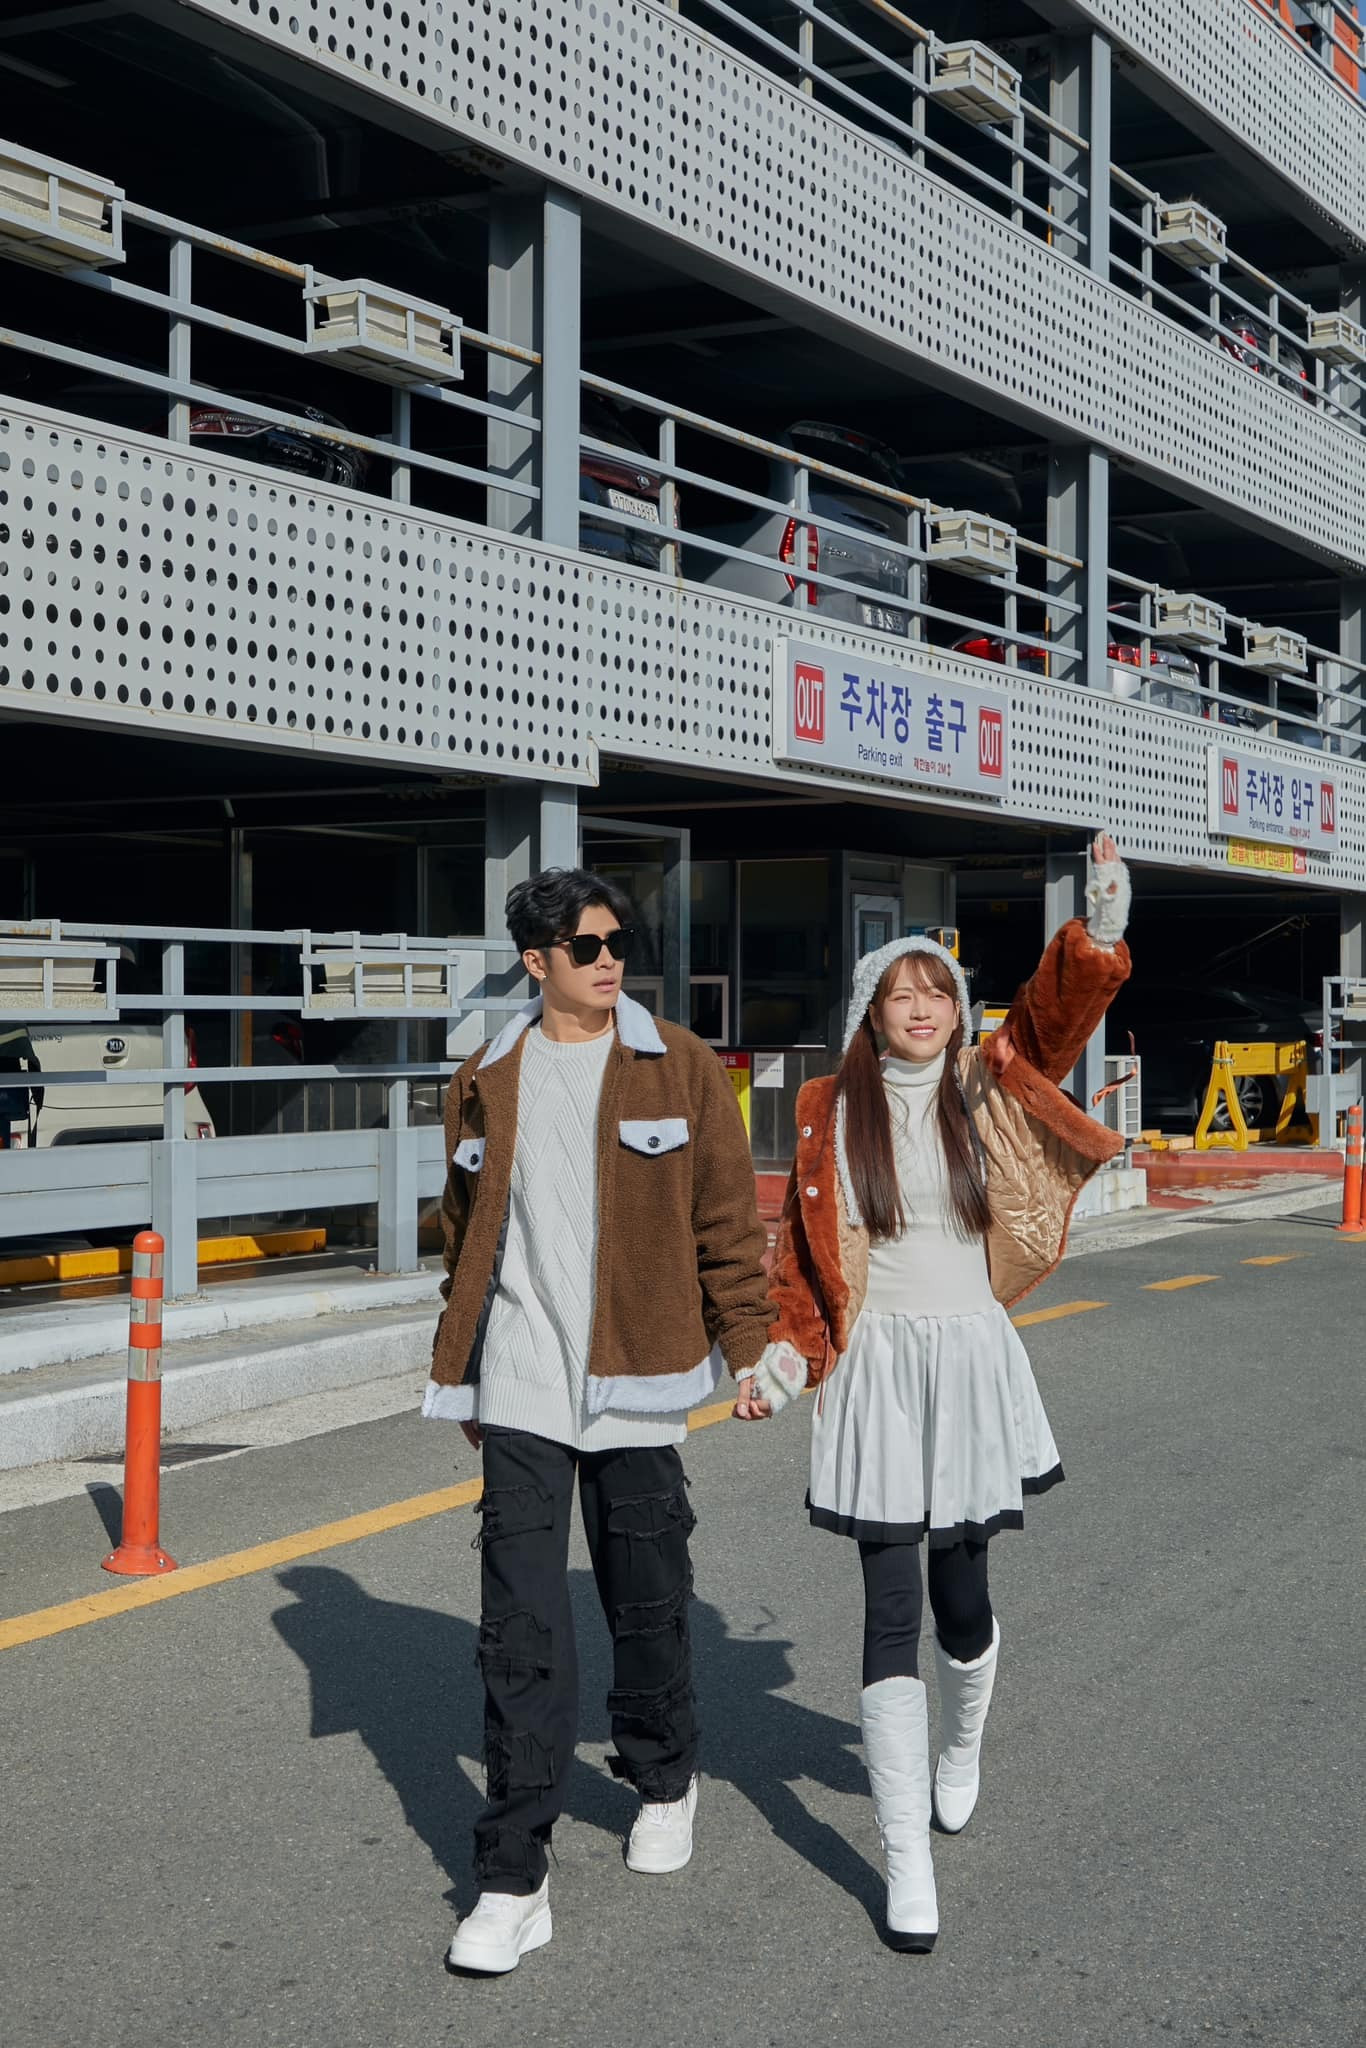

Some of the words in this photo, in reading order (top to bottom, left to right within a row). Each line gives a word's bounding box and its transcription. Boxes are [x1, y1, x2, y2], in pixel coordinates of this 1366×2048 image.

[797, 675, 823, 730] OUT
[840, 672, 912, 744] 주차장
[925, 693, 967, 753] 출구
[858, 744, 888, 768] Parking
[889, 753, 903, 768] exit
[980, 719, 1001, 767] OUT
[1224, 767, 1237, 807] IN
[1246, 769, 1284, 817] 주차장
[1291, 778, 1314, 823] 입구
[1321, 791, 1333, 826] IN
[1249, 816, 1265, 832] Parking
[1266, 822, 1284, 834] entrance
